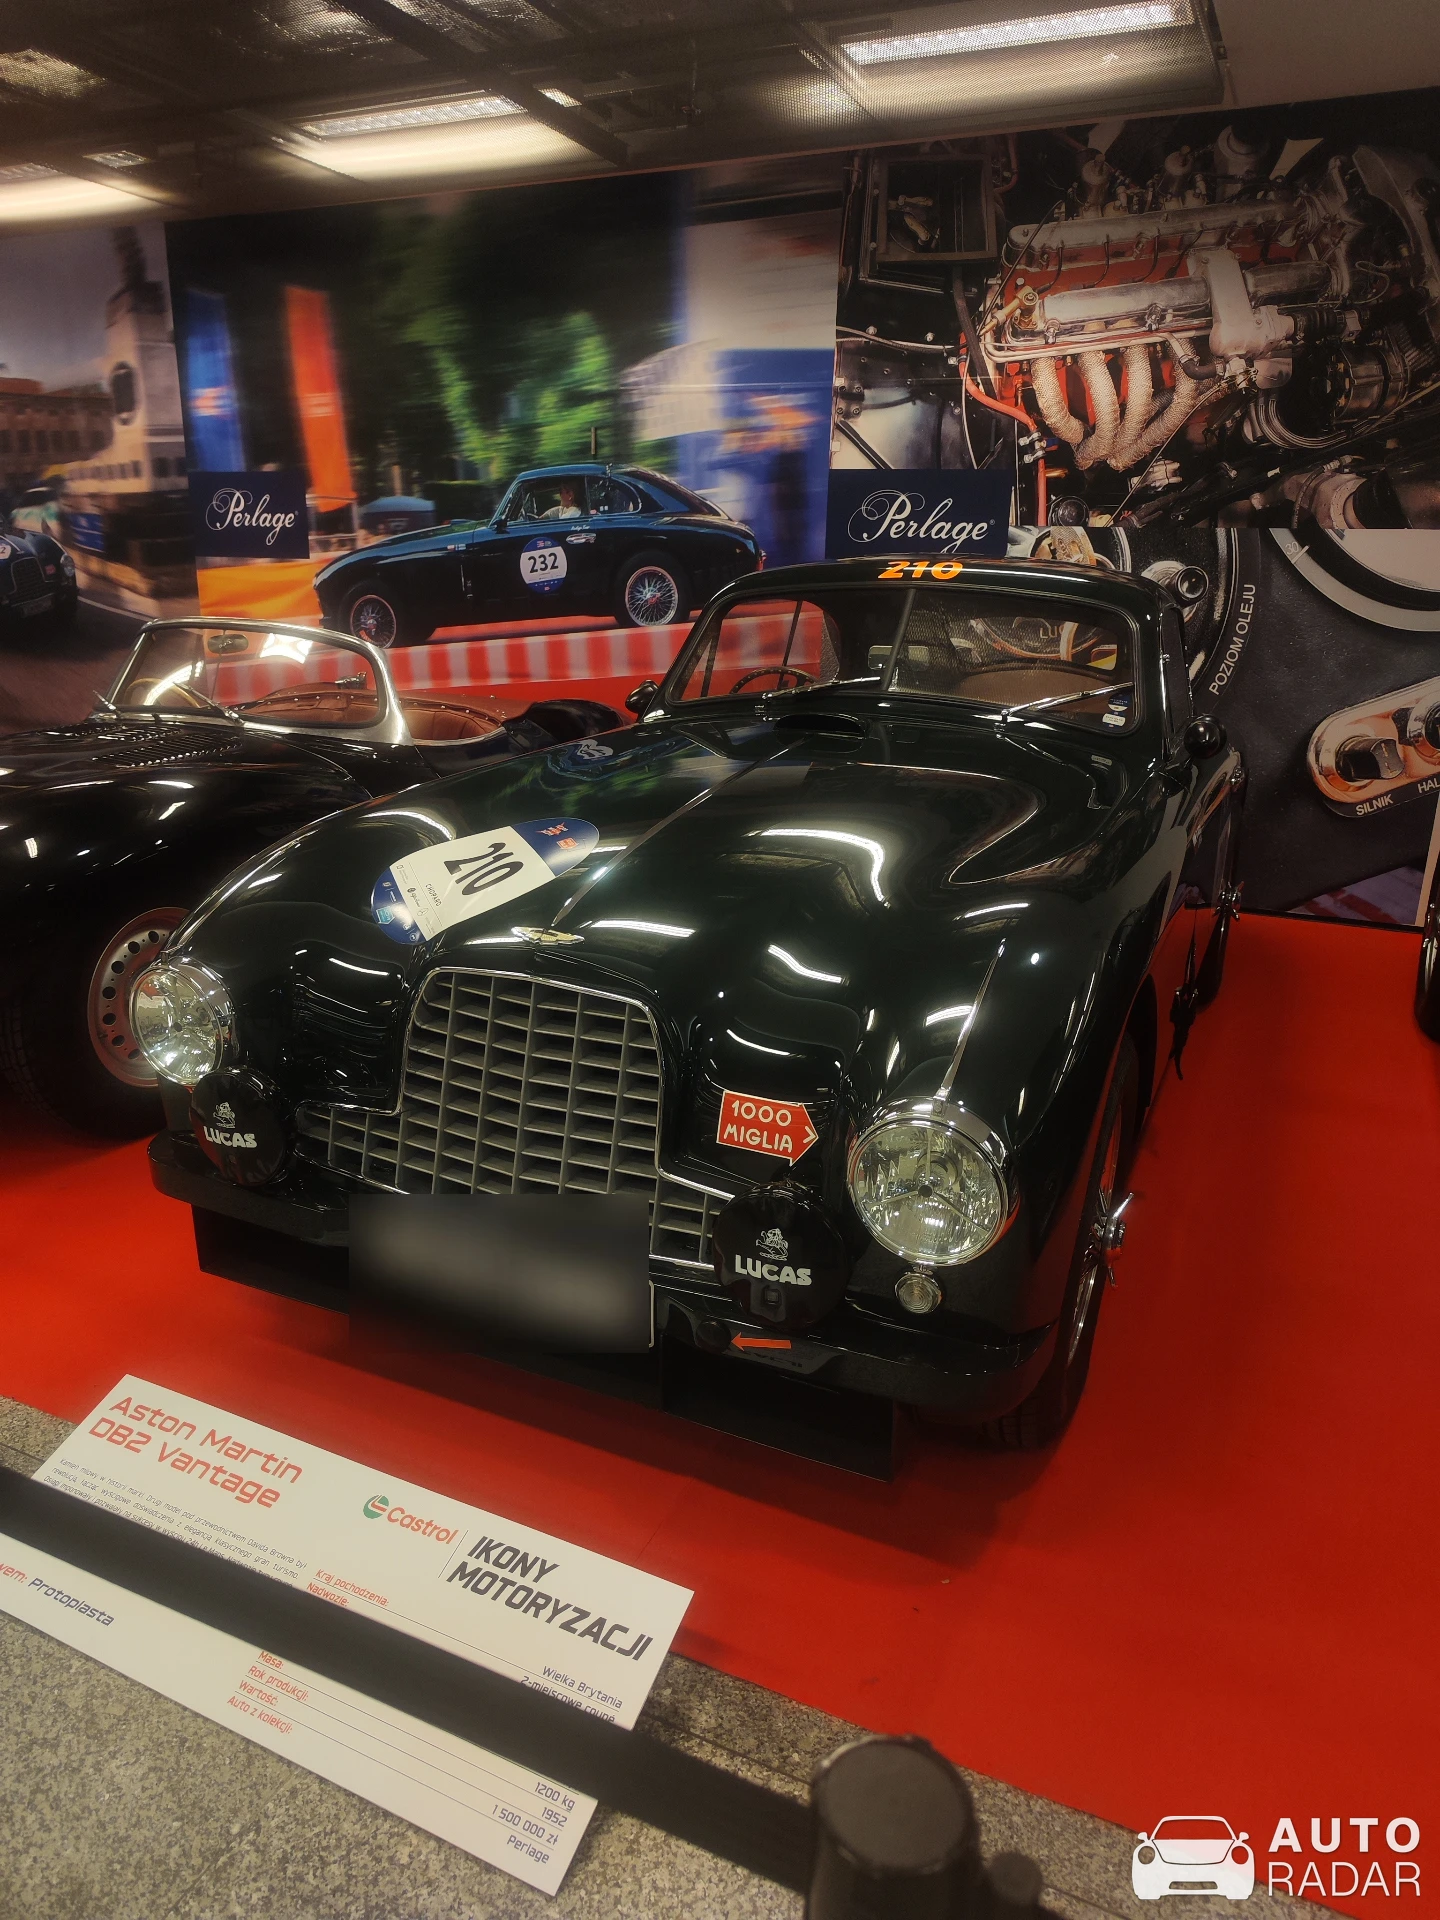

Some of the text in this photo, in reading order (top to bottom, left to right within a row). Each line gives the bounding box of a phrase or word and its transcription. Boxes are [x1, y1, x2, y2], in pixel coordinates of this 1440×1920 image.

[205, 487, 296, 546] Perlage
[847, 489, 989, 554] Perlage
[527, 552, 559, 574] 232
[877, 560, 964, 580] 210
[1285, 541, 1299, 555] 30
[1208, 584, 1256, 695] POZIOM OLEJU
[1355, 794, 1394, 816] SILNIK
[443, 842, 524, 896] 210
[203, 1125, 258, 1149] LUCAS
[723, 1123, 793, 1153] MIGLIA
[732, 1100, 792, 1127] 1000
[735, 1254, 813, 1286] LUCAS
[88, 1417, 281, 1509] DB2 Vantage
[109, 1396, 303, 1484] Aston Martin
[181, 1511, 195, 1521] pod
[247, 1538, 270, 1554] Davida
[269, 1548, 295, 1563] Browna
[387, 1506, 459, 1545] Castrol
[254, 1555, 270, 1566] gran
[467, 1535, 560, 1584] IKONY
[28, 1577, 115, 1627] Protoplasta
[306, 1582, 349, 1607] Nadwozie:
[446, 1560, 654, 1661] MOTORYZACJI
[315, 1569, 623, 1709] Kraj pochodzenia: Wielka Brytania
[247, 1665, 568, 1828] Rok produkcji: 1952
[258, 1650, 576, 1812] Masa: 1200 kg
[227, 1695, 550, 1864] Auto z kolekcji: Perlage
[239, 1679, 559, 1845] Wartość: 1 500 000 zł
